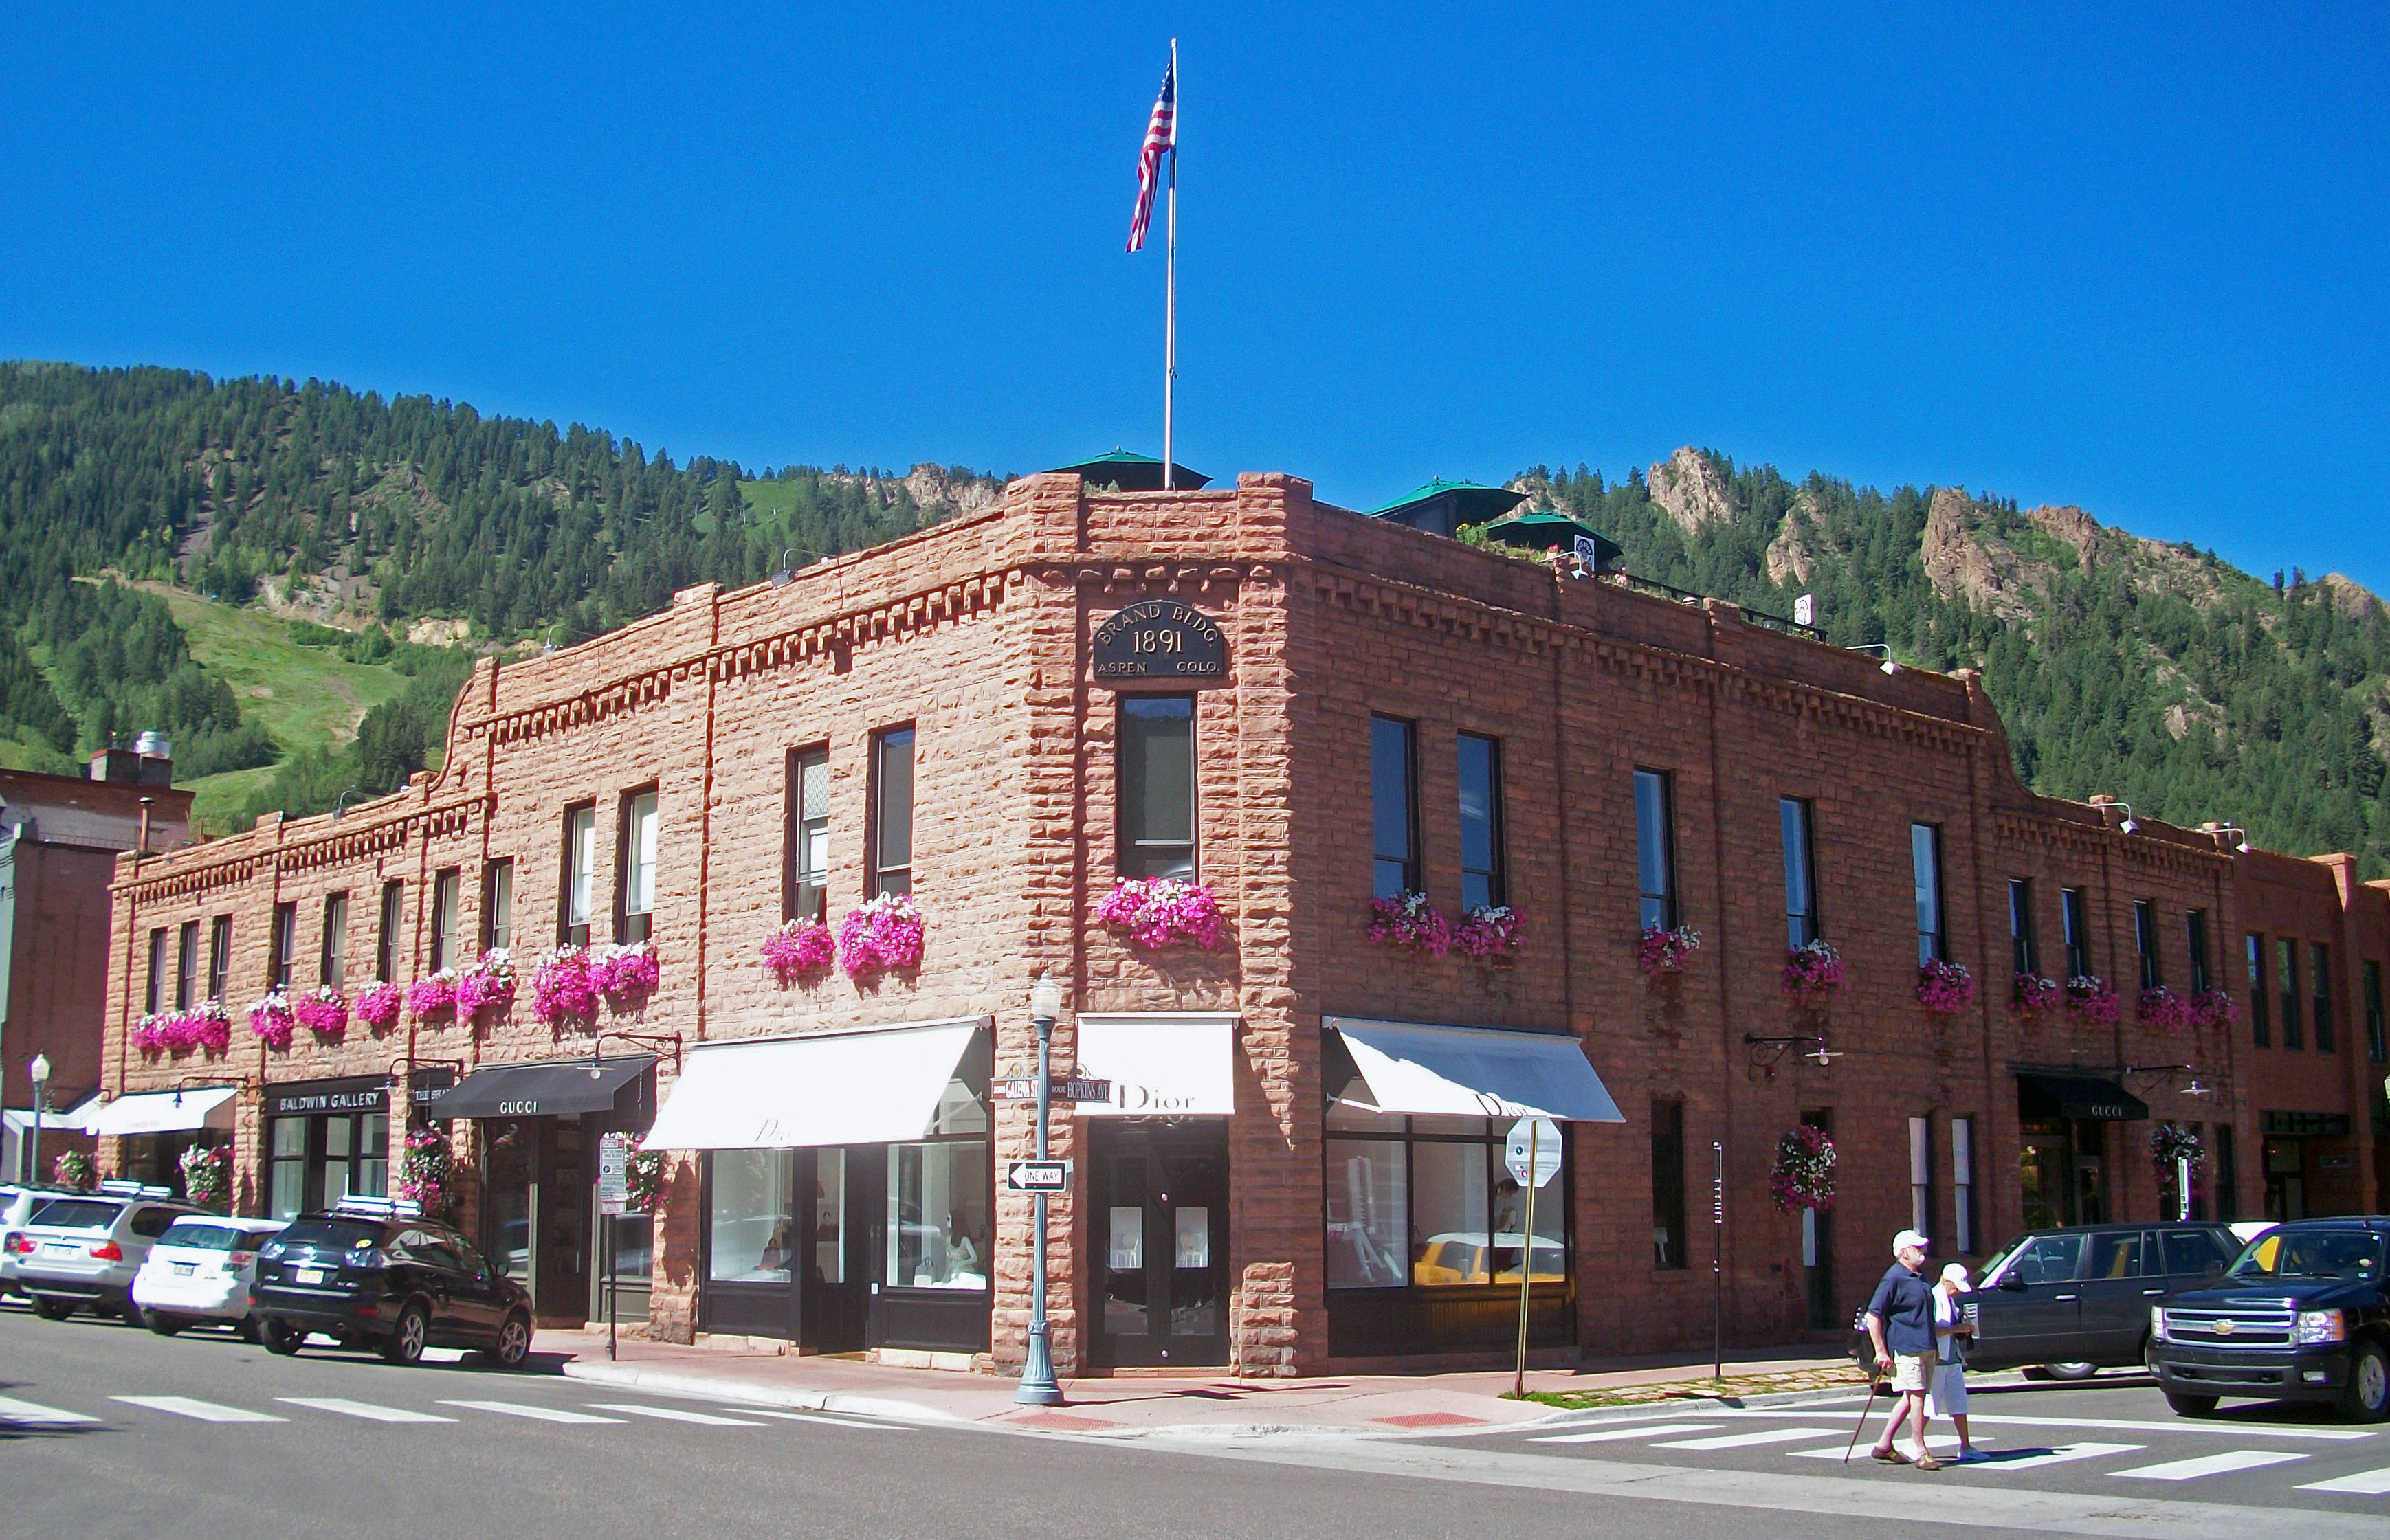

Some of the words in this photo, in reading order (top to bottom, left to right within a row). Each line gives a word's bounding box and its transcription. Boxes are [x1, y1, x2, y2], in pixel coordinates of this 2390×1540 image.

[1097, 604, 1161, 646] BRAND
[1133, 629, 1184, 654] 1891
[1098, 662, 1147, 673] ASPEN
[1006, 1080, 1030, 1099] GALENA
[1067, 1081, 1096, 1100] HOPKINS
[1096, 1082, 1109, 1100] AVE
[1119, 1084, 1195, 1109] Dior
[280, 1095, 327, 1111] BALDWIN
[331, 1092, 380, 1108] GALLERY
[500, 1100, 538, 1114] GUCCI
[1473, 1093, 1528, 1117] Dior
[2092, 1105, 2122, 1117] GUCCI
[1024, 1170, 1039, 1181] ONE
[1042, 1171, 1059, 1181] WAY
